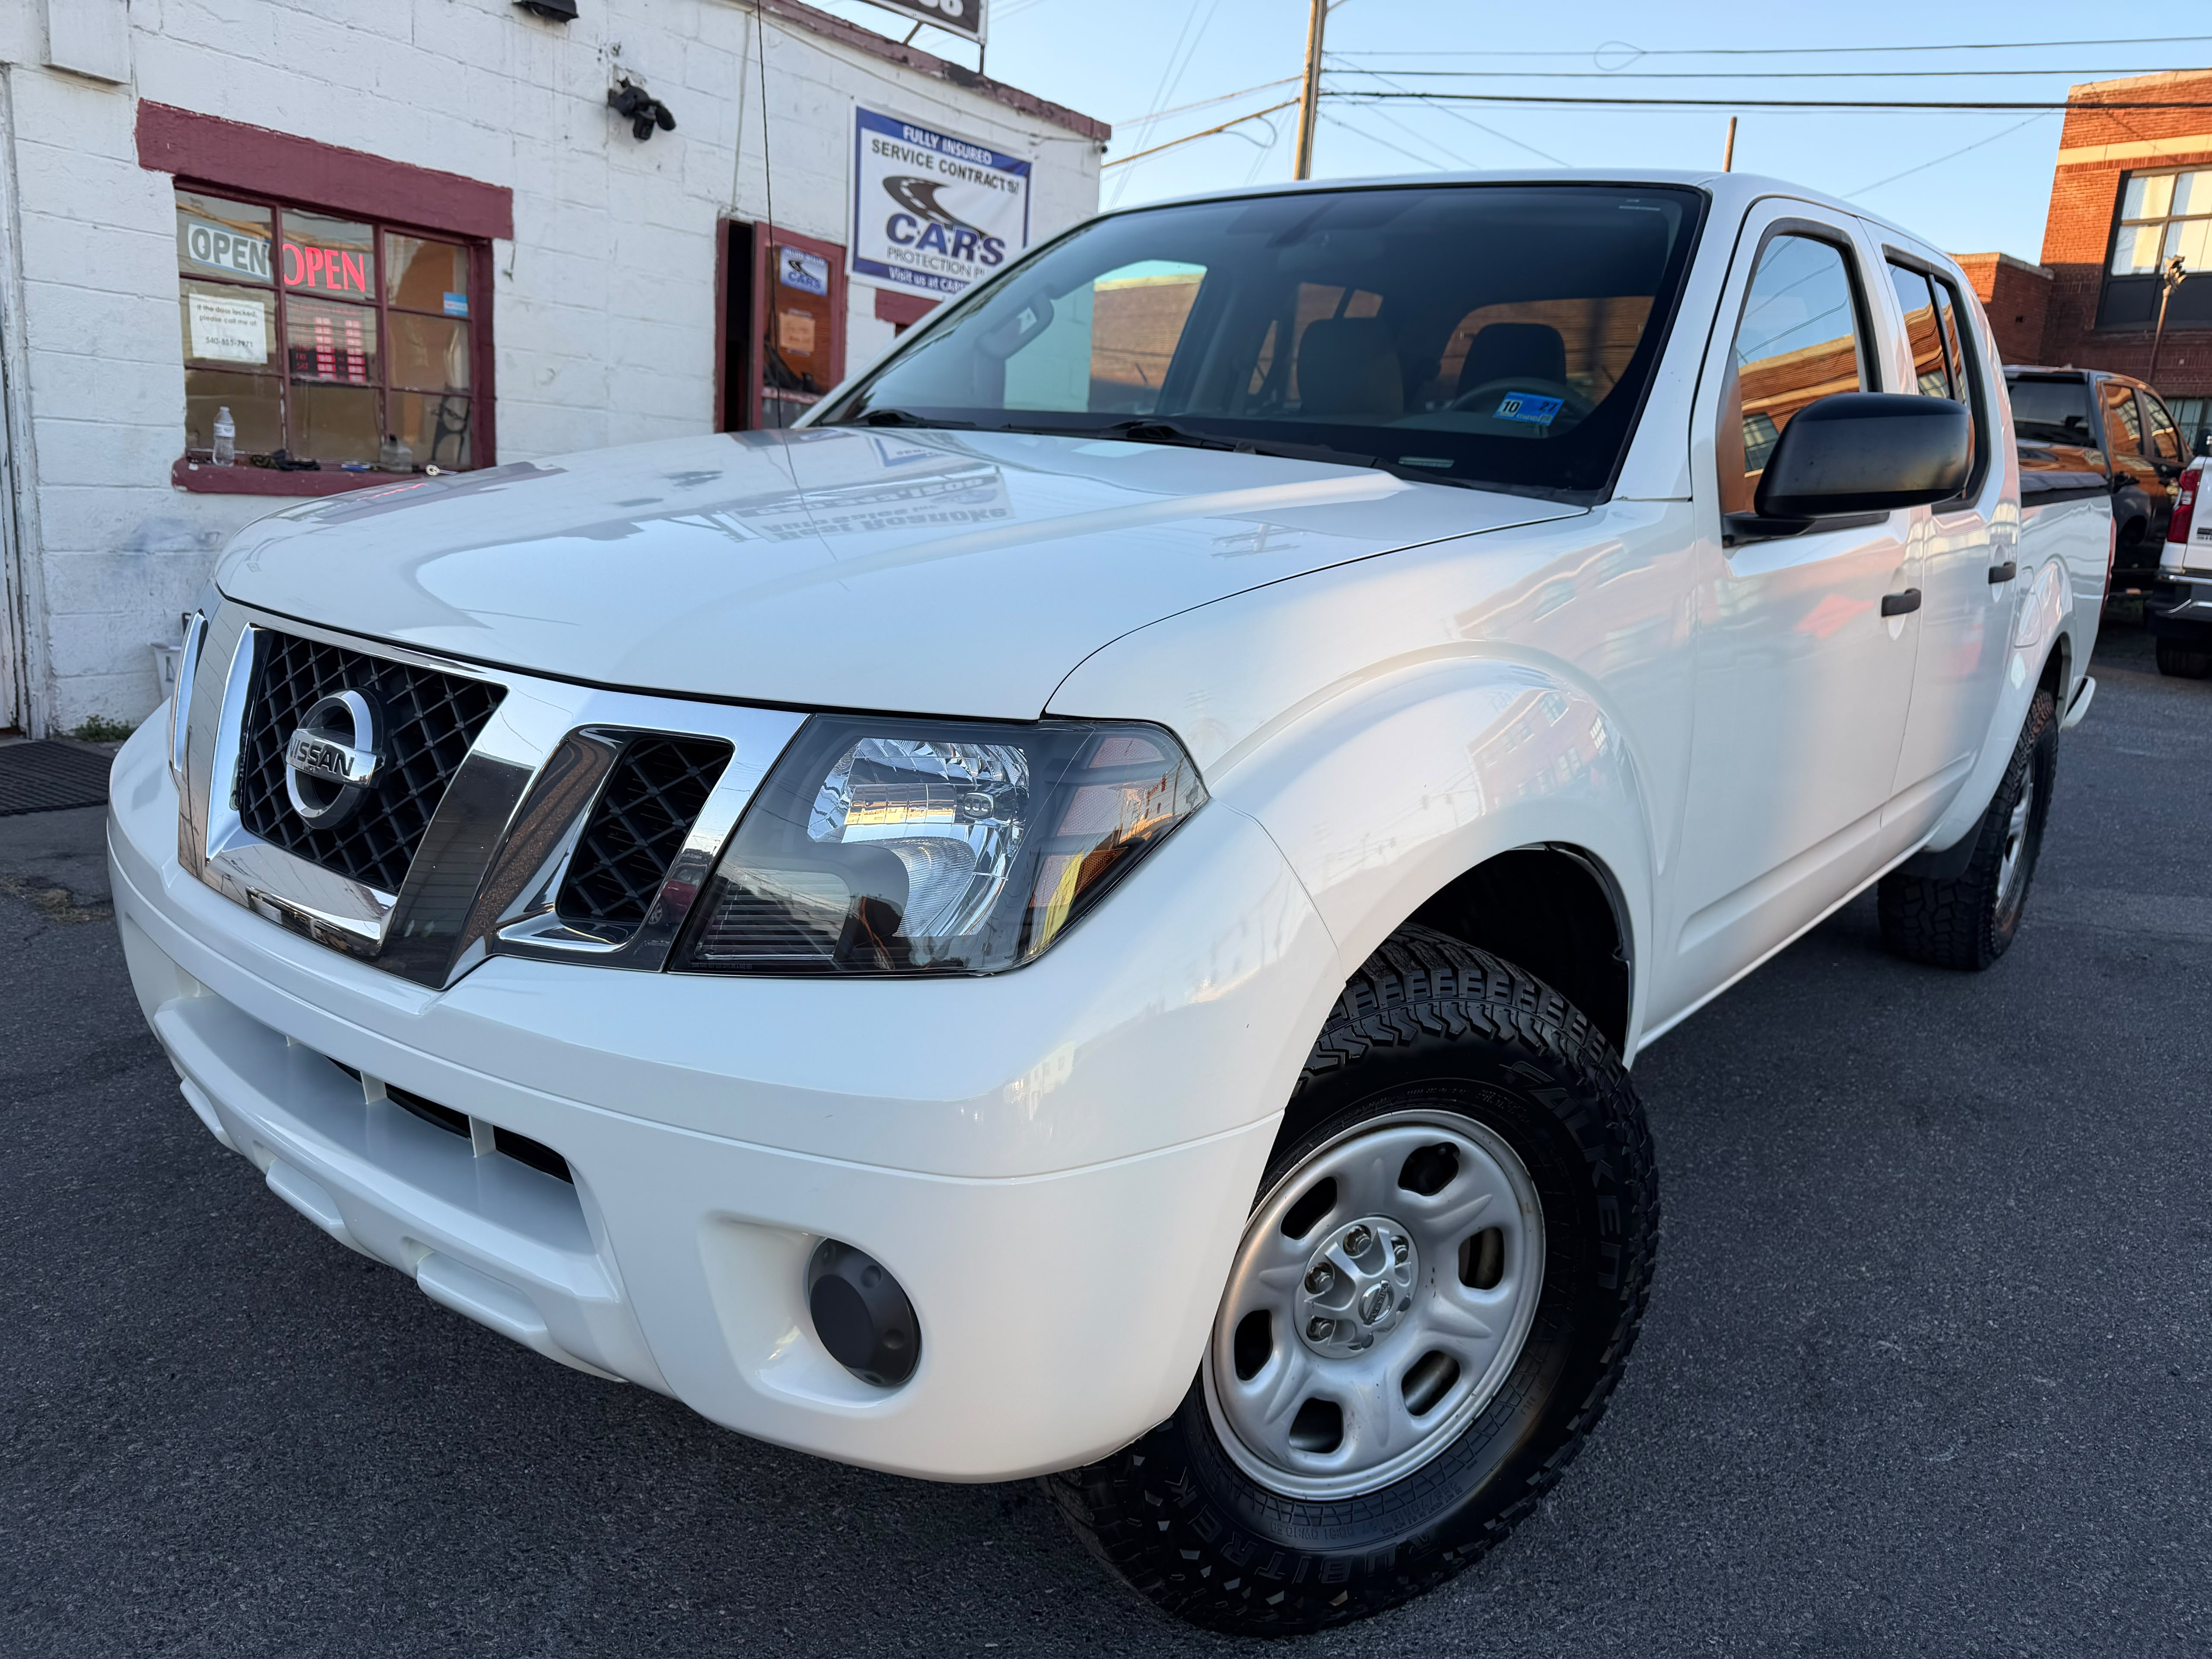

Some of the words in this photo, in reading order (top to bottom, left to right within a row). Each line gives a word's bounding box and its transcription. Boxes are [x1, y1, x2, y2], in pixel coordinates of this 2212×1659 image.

[872, 139, 934, 169] SERVICE
[903, 124, 940, 149] FULLY
[942, 137, 992, 165] INSURED
[191, 228, 267, 275] OPEN
[283, 244, 365, 292] OPEN
[887, 247, 971, 277] PROTECTION
[889, 266, 913, 284] Visit
[914, 273, 926, 286] us
[928, 276, 939, 290] at
[1503, 400, 1520, 413] 10
[1539, 401, 1558, 413] 27
[288, 736, 355, 778] NISSAN
[1498, 1060, 1623, 1290] FALKEN
[1369, 1285, 1388, 1322] NISSAN
